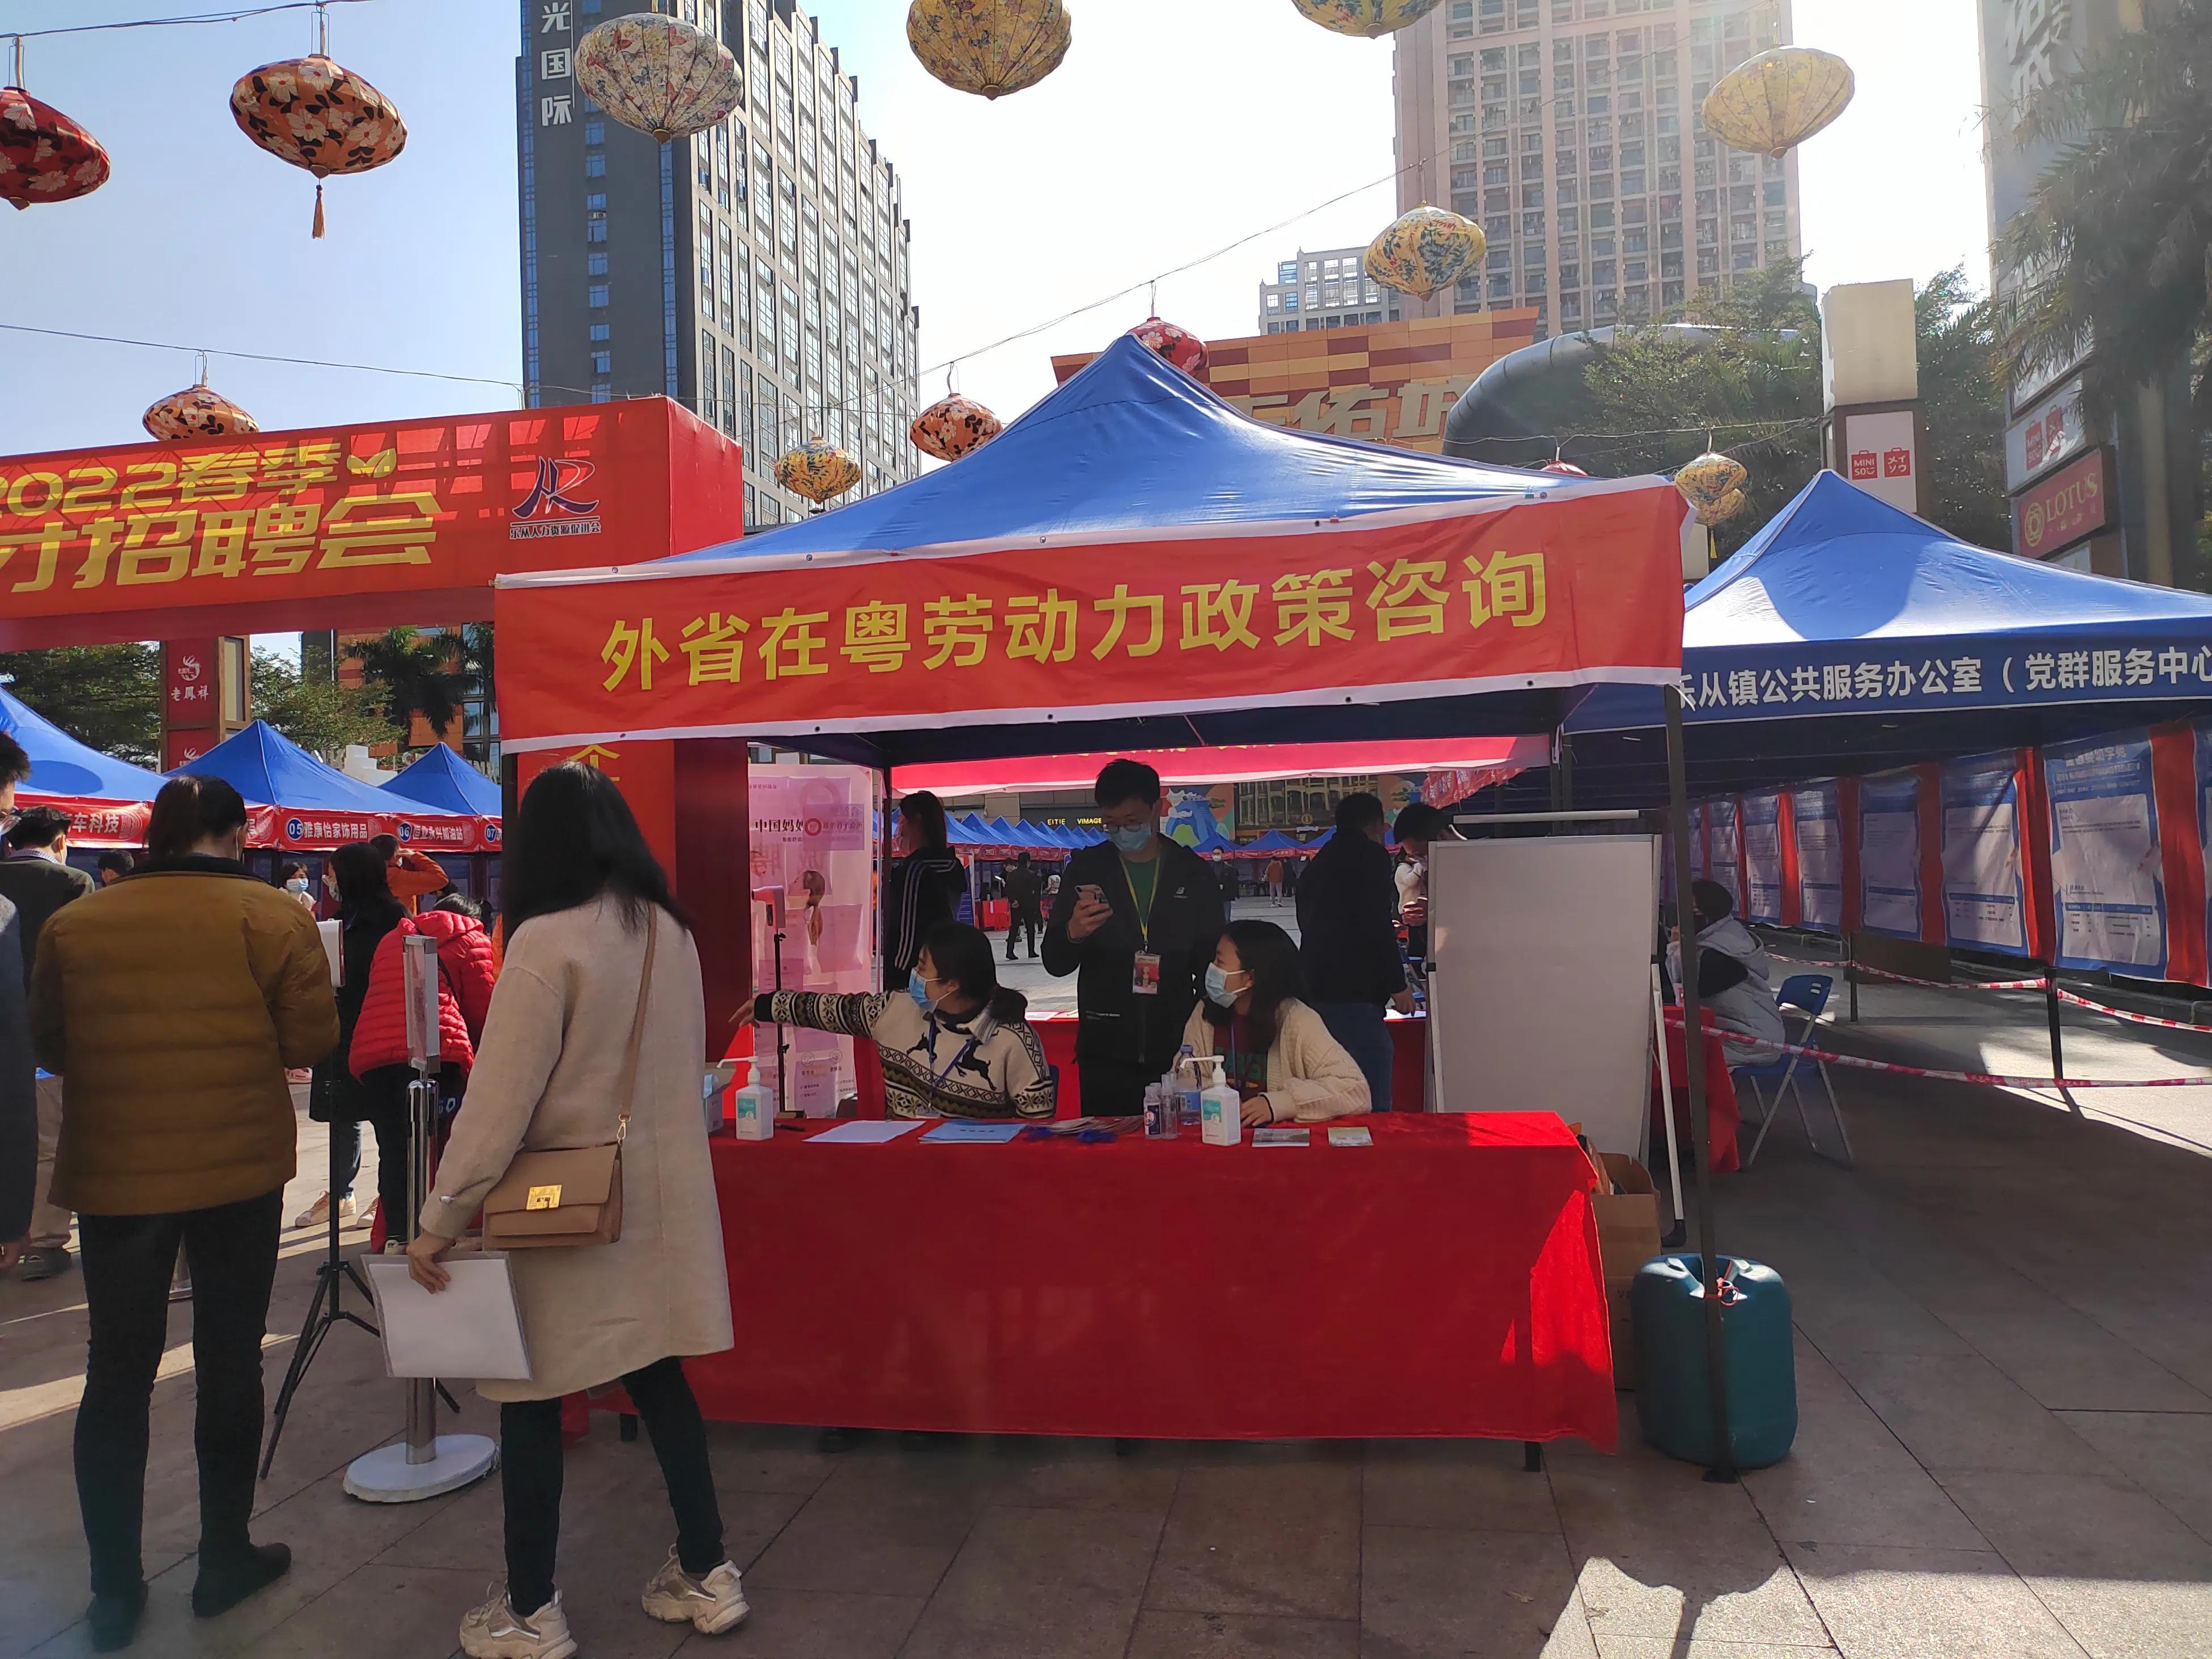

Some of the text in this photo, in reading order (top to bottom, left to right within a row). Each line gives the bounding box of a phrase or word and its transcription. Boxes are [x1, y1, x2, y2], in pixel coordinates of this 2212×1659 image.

[541, 1, 572, 127] 光国际
[1853, 457, 1875, 467] MINI
[0, 443, 342, 519] 022春季
[2045, 472, 2098, 523] LOTUS
[509, 521, 602, 540] 乐从人力资源促进会
[600, 550, 1547, 693] 外省在粤劳动力政策咨询
[171, 684, 209, 702] 老鳳祥
[67, 811, 120, 834] 车科技
[288, 822, 304, 836] 05
[303, 821, 368, 840] 雅康怡家饰用品
[398, 826, 410, 839] 06
[486, 827, 496, 839] 07
